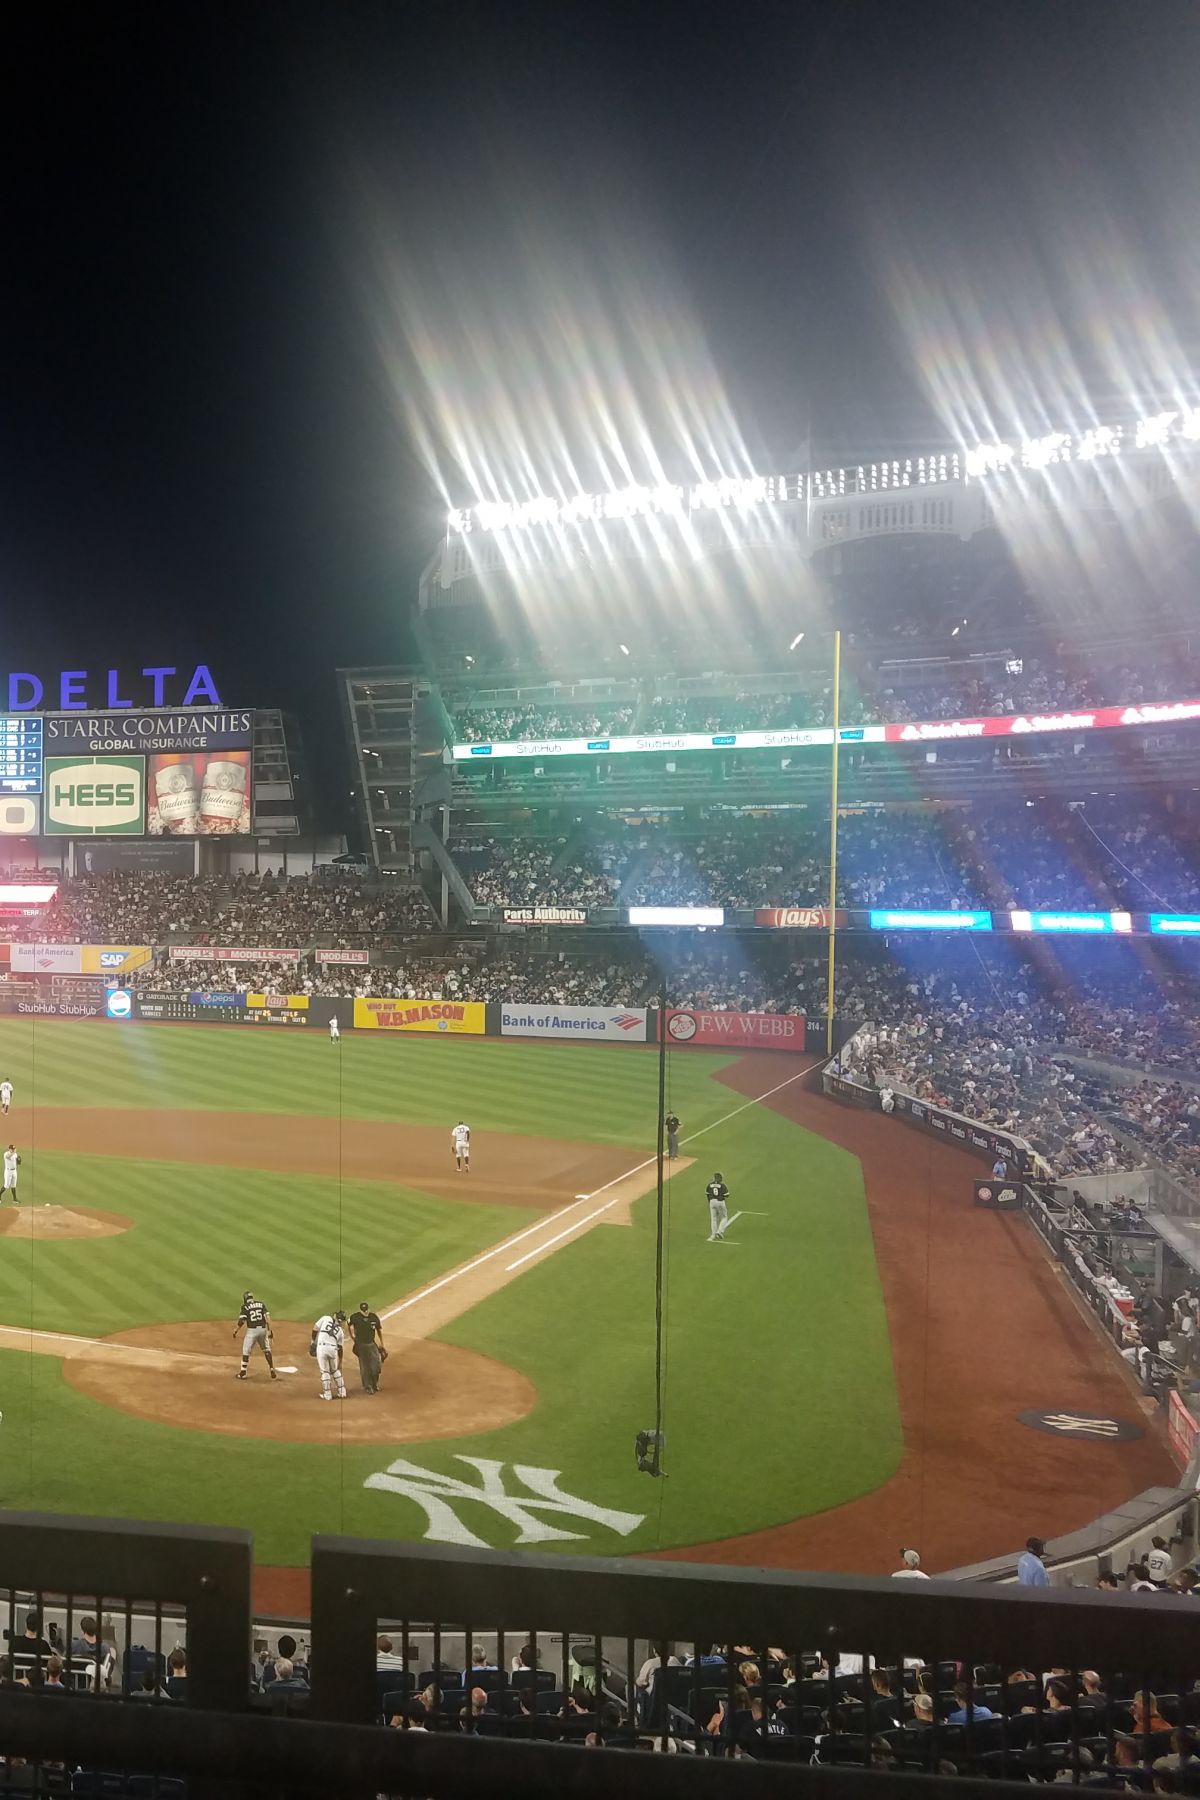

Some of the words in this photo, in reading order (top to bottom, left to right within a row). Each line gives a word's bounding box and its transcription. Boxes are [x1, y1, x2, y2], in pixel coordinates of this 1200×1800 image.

[9, 665, 221, 712] DELTA
[48, 719, 114, 739] STARR
[122, 713, 250, 736] COMPANIES
[90, 739, 136, 751] GLOBAL
[139, 737, 207, 750] INSURANCE
[764, 734, 813, 745] StubHub
[54, 784, 135, 807] HESS
[504, 909, 532, 919] Parts
[534, 907, 586, 920] Authority
[19, 947, 36, 955] Bank
[45, 948, 74, 956] America
[320, 952, 364, 961] MODELL'S
[101, 954, 124, 966] SAP
[212, 994, 235, 1003] pepsi
[18, 1002, 57, 1014] StubHub
[60, 1004, 97, 1016] StubHub
[502, 1014, 535, 1027] Bank
[537, 1014, 551, 1028] of
[552, 1015, 606, 1031] America
[699, 1015, 734, 1034] F.W.
[739, 1016, 795, 1037] WEBB
[807, 1021, 820, 1031] 314
[249, 1309, 263, 1321] 25
[363, 1454, 648, 1550] NY
[1150, 1559, 1164, 1571] 27
